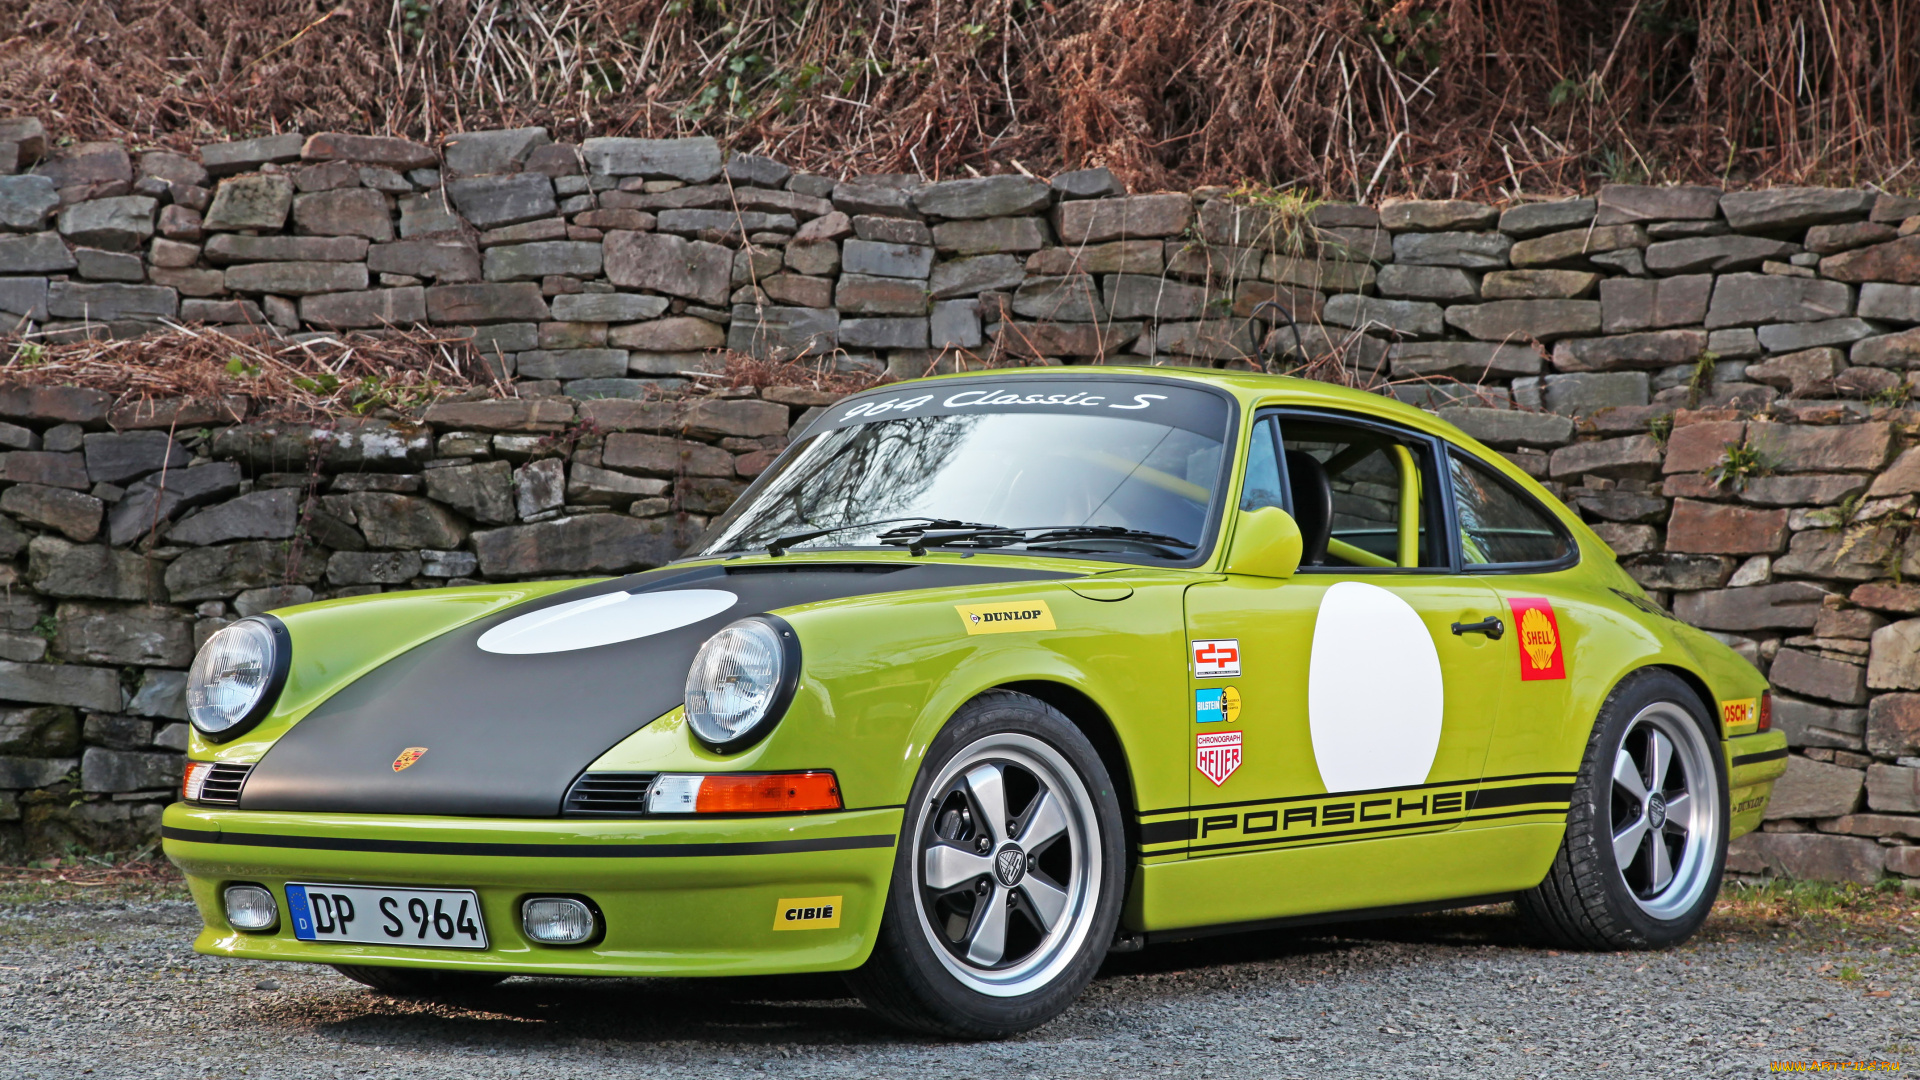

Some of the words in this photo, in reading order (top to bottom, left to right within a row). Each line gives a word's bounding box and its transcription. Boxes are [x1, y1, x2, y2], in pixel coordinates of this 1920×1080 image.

[839, 394, 935, 422] 964
[943, 389, 1105, 408] Classic
[1108, 394, 1168, 410] S
[983, 609, 1041, 622] DUNLOP
[1526, 630, 1552, 645] SHELL
[1195, 643, 1238, 668] dp
[1196, 700, 1219, 711] BILSTEIN
[1198, 734, 1241, 745] CHRONOGRAPH
[1199, 748, 1240, 782] HEUER
[1737, 796, 1764, 813] DUNLOP
[1201, 791, 1462, 839] PORSCHE
[309, 892, 355, 935] DP
[785, 904, 833, 921] CIBIÉ
[298, 917, 308, 930] D
